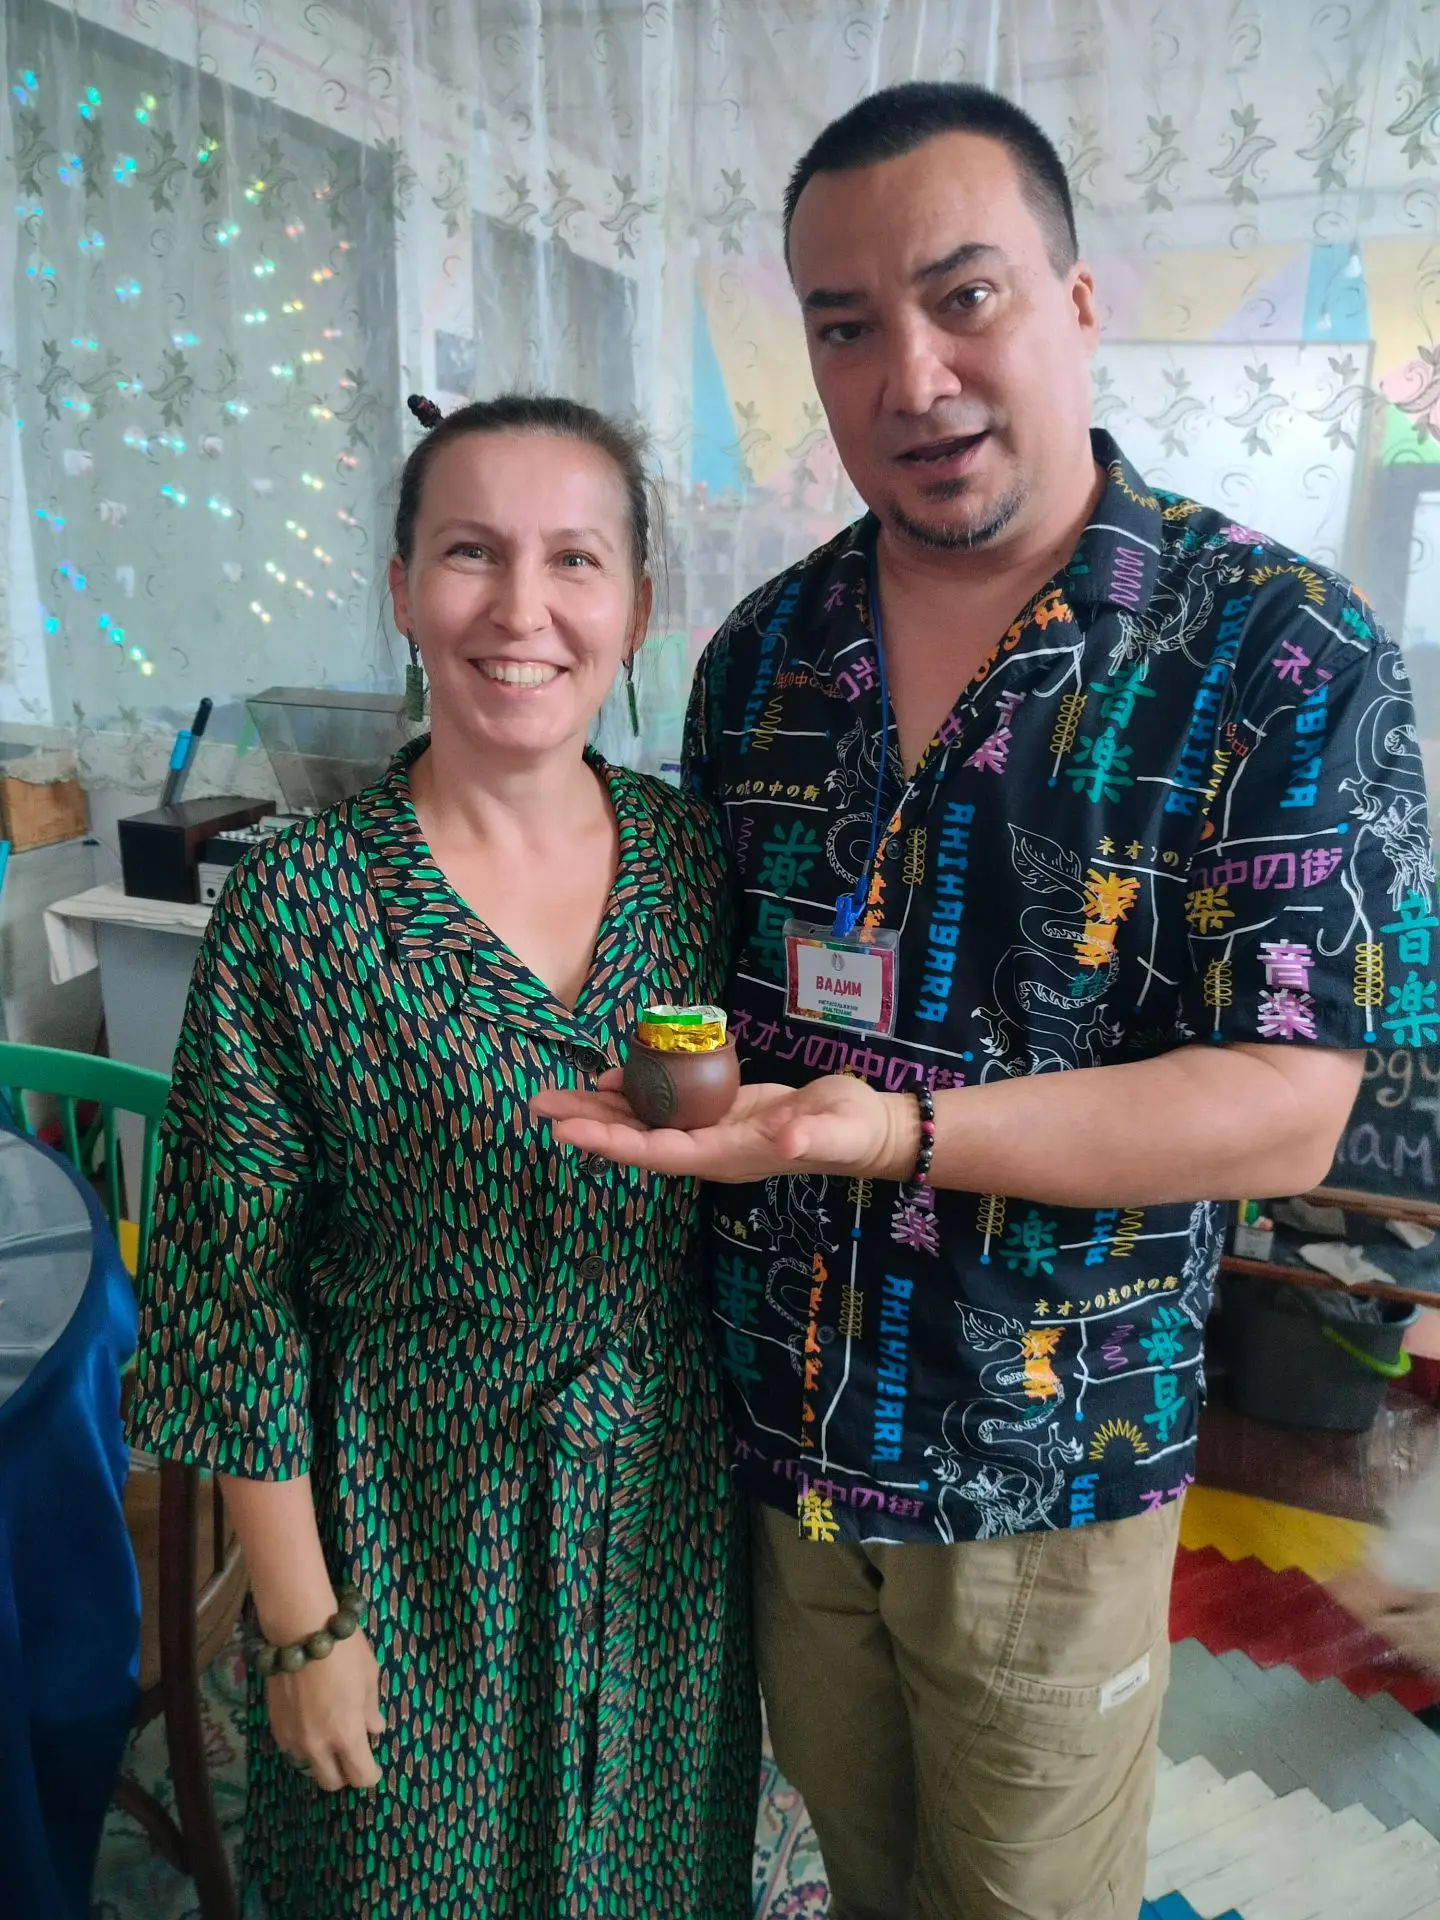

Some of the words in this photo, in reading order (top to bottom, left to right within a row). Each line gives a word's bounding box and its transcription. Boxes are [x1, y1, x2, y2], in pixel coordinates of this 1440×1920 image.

[1066, 664, 1157, 804] 音楽
[914, 802, 976, 1024] AKIHABARA
[1379, 889, 1440, 1047] 音楽
[816, 975, 862, 997] ВАДИМ
[1256, 939, 1318, 1040] 音楽
